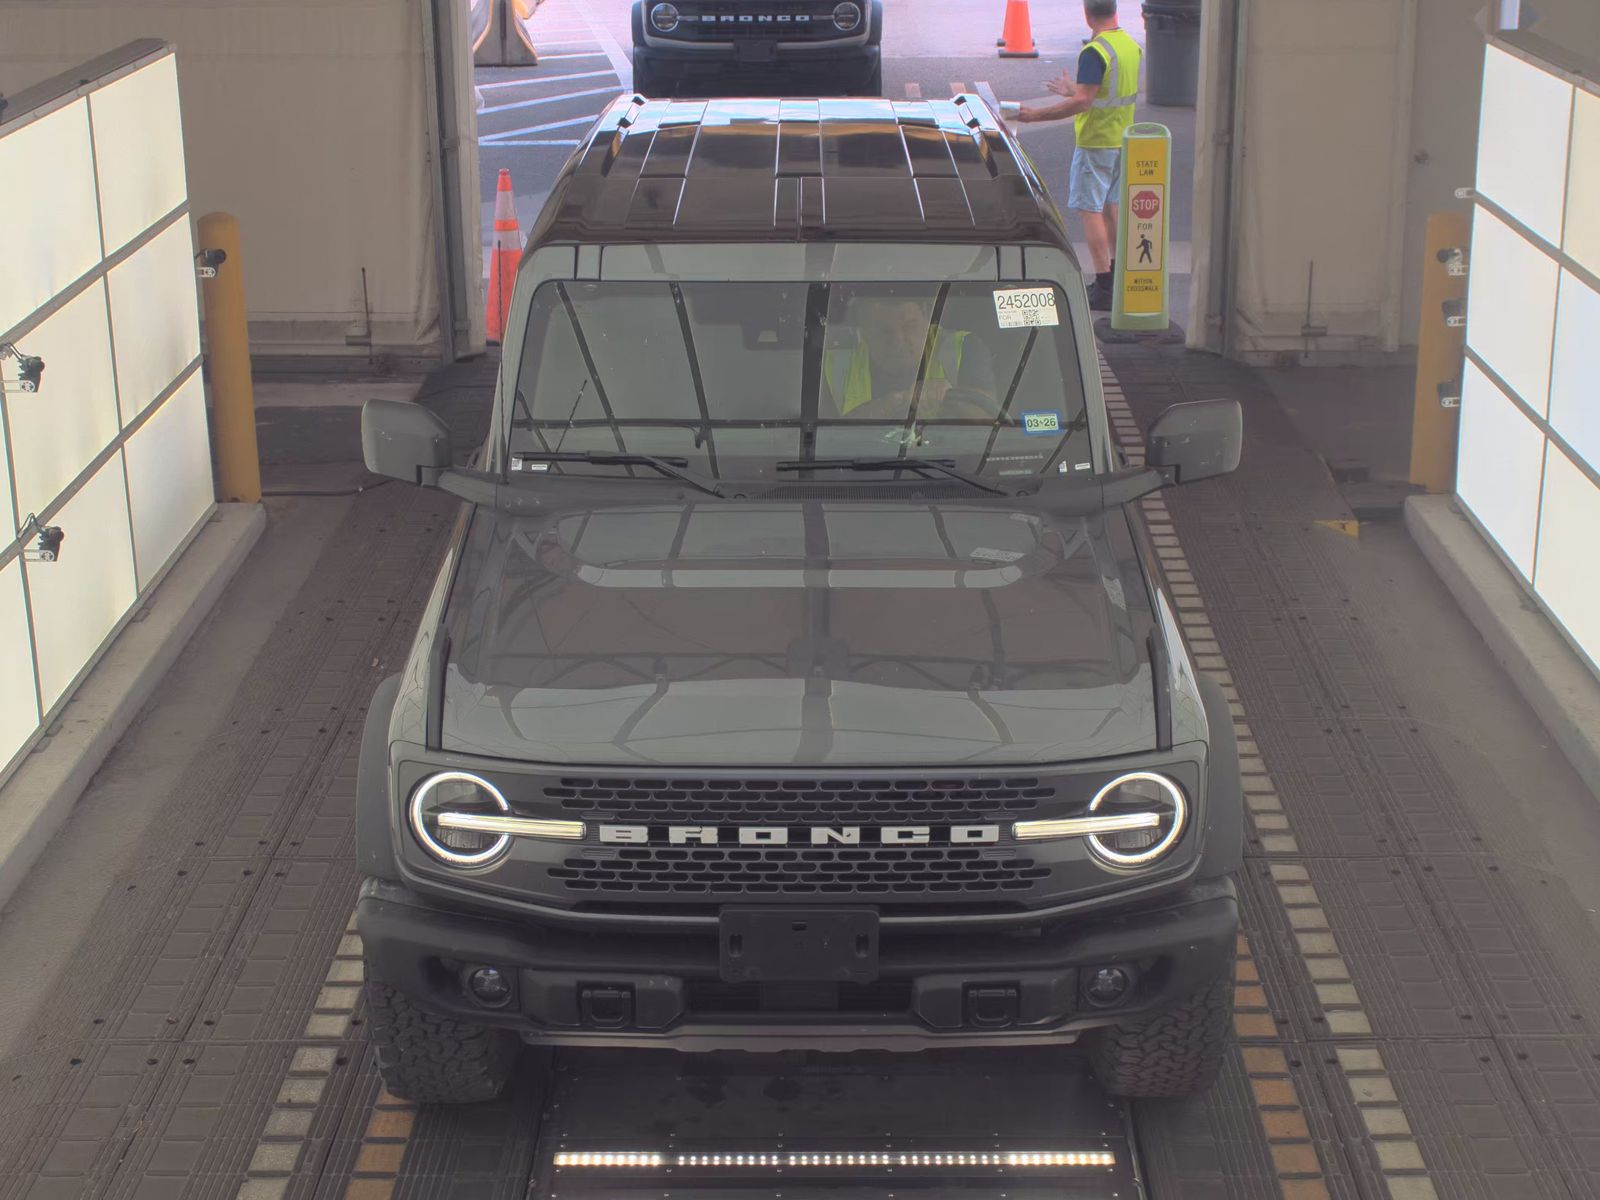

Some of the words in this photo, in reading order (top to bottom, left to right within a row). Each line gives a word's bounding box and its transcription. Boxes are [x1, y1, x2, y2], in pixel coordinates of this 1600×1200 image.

[1136, 160, 1158, 168] STATE
[1133, 199, 1159, 210] STOP
[1137, 222, 1153, 230] FOR
[998, 293, 1056, 309] 2452008
[599, 825, 1000, 845] BRONCO
